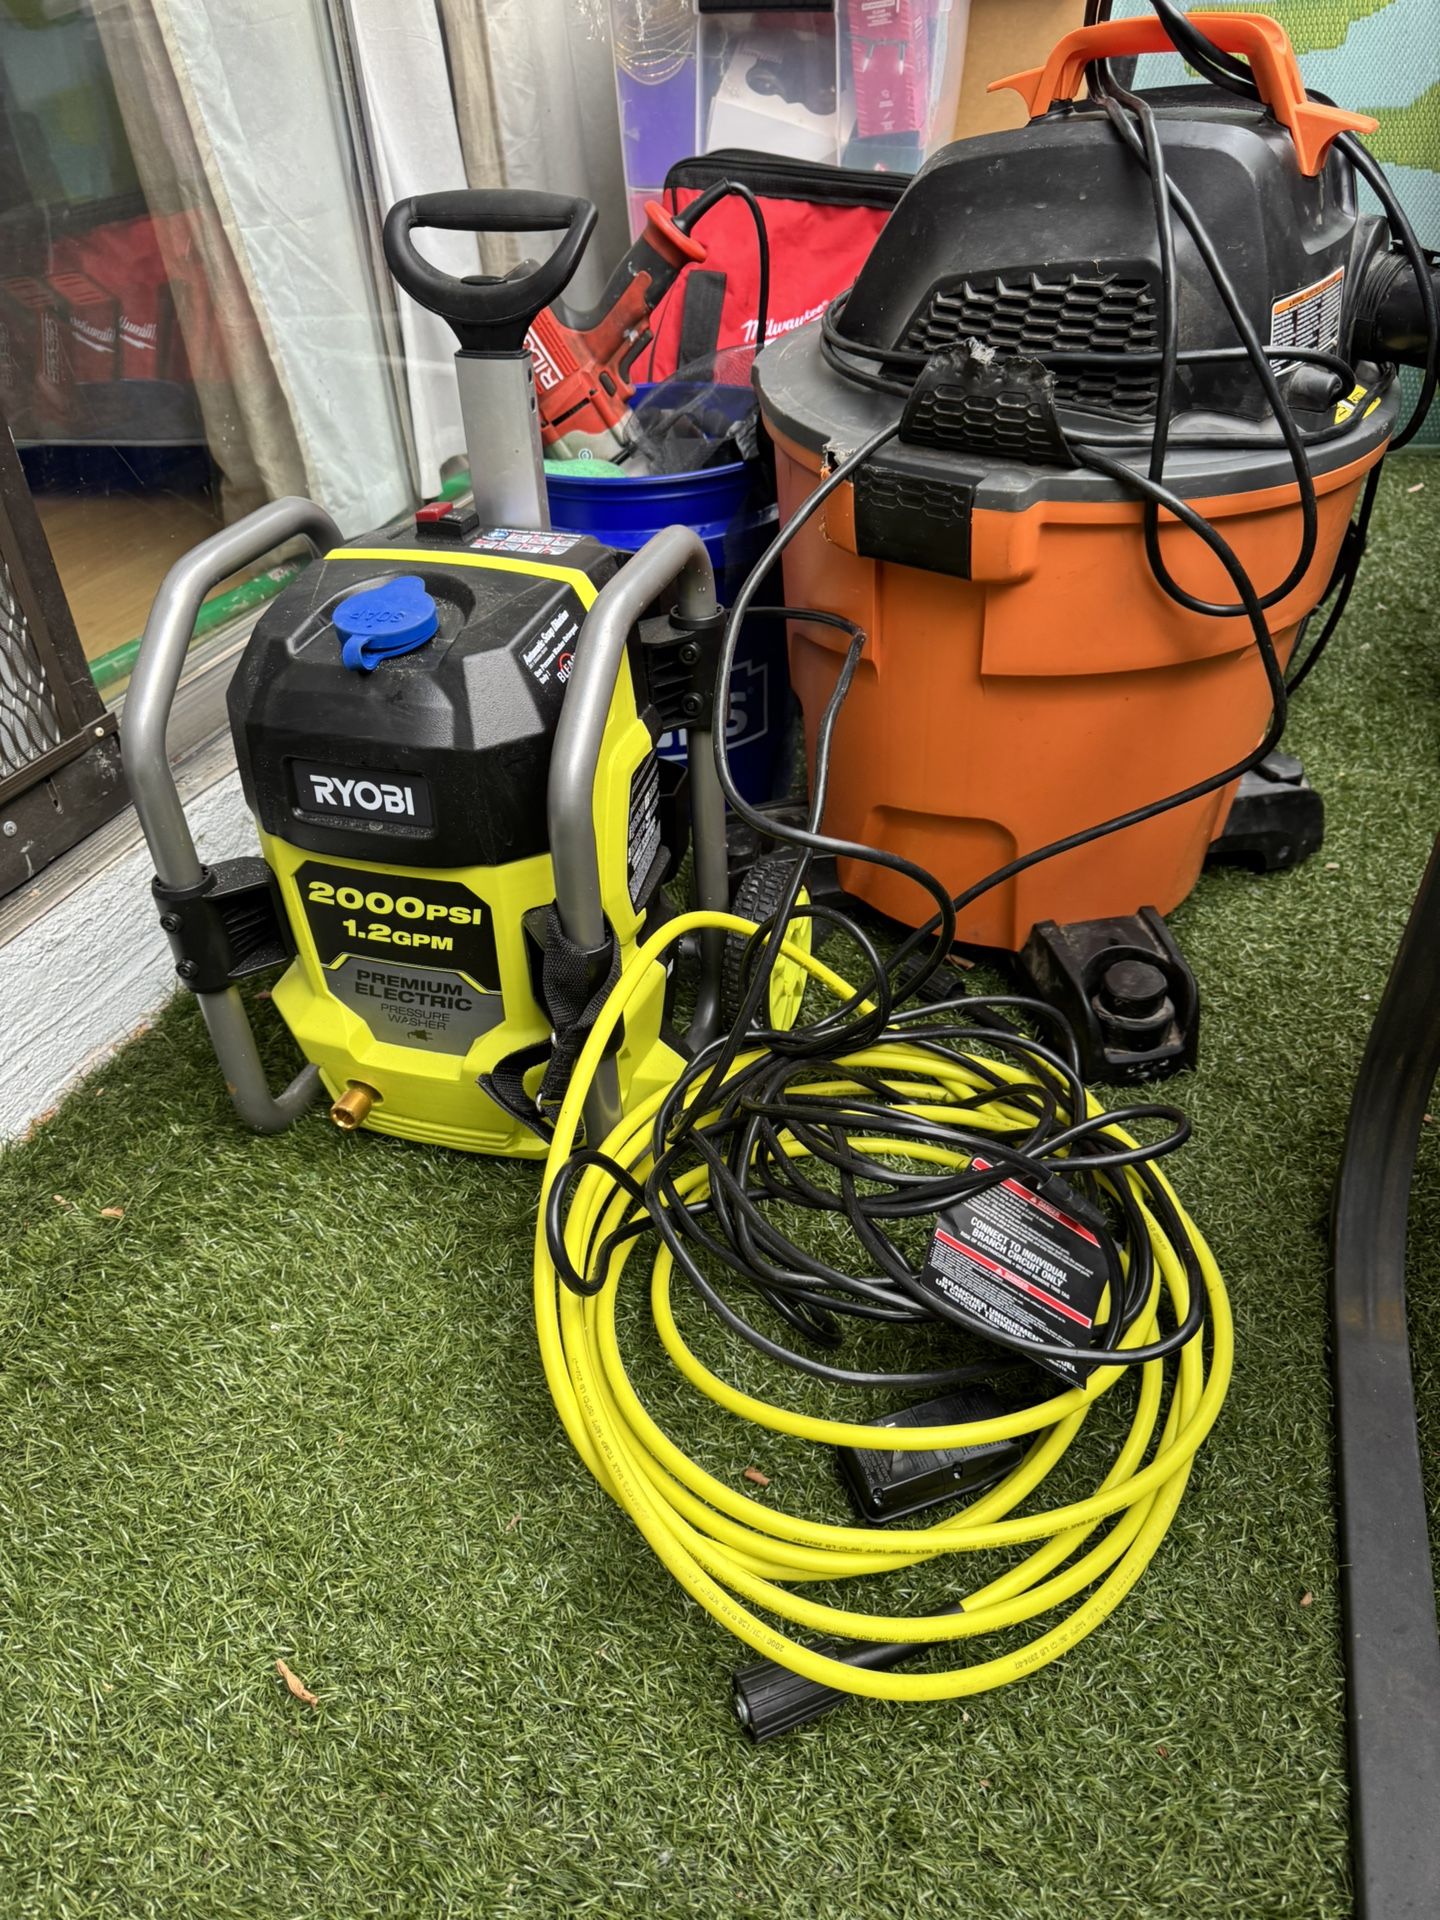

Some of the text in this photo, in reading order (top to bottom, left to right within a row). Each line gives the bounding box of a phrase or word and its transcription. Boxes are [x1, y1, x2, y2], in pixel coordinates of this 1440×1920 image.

[741, 302, 824, 343] Mlwaukee
[541, 627, 555, 644] Soap
[310, 774, 415, 816] RYOBI
[308, 881, 482, 925] 2000PSI
[342, 919, 453, 951] 1.2GPM
[354, 981, 473, 1012] ELECTRIC
[356, 969, 462, 996] PREMIUM
[381, 1003, 450, 1023] PRESSURE
[388, 1014, 446, 1031] WASHER
[1037, 1200, 1061, 1219] DANGER
[970, 1216, 1010, 1245] CONNECT
[1008, 1240, 1022, 1253] TO
[1021, 1248, 1070, 1282] INDIVIDUAL
[971, 1227, 1008, 1254] BRANCH
[1006, 1249, 1042, 1275] CIRCUIT
[1040, 1269, 1064, 1288] ONLY
[942, 1277, 988, 1310] BRANCHER
[1003, 1272, 1030, 1291] DANGER
[948, 1288, 984, 1313] CIRCUIT
